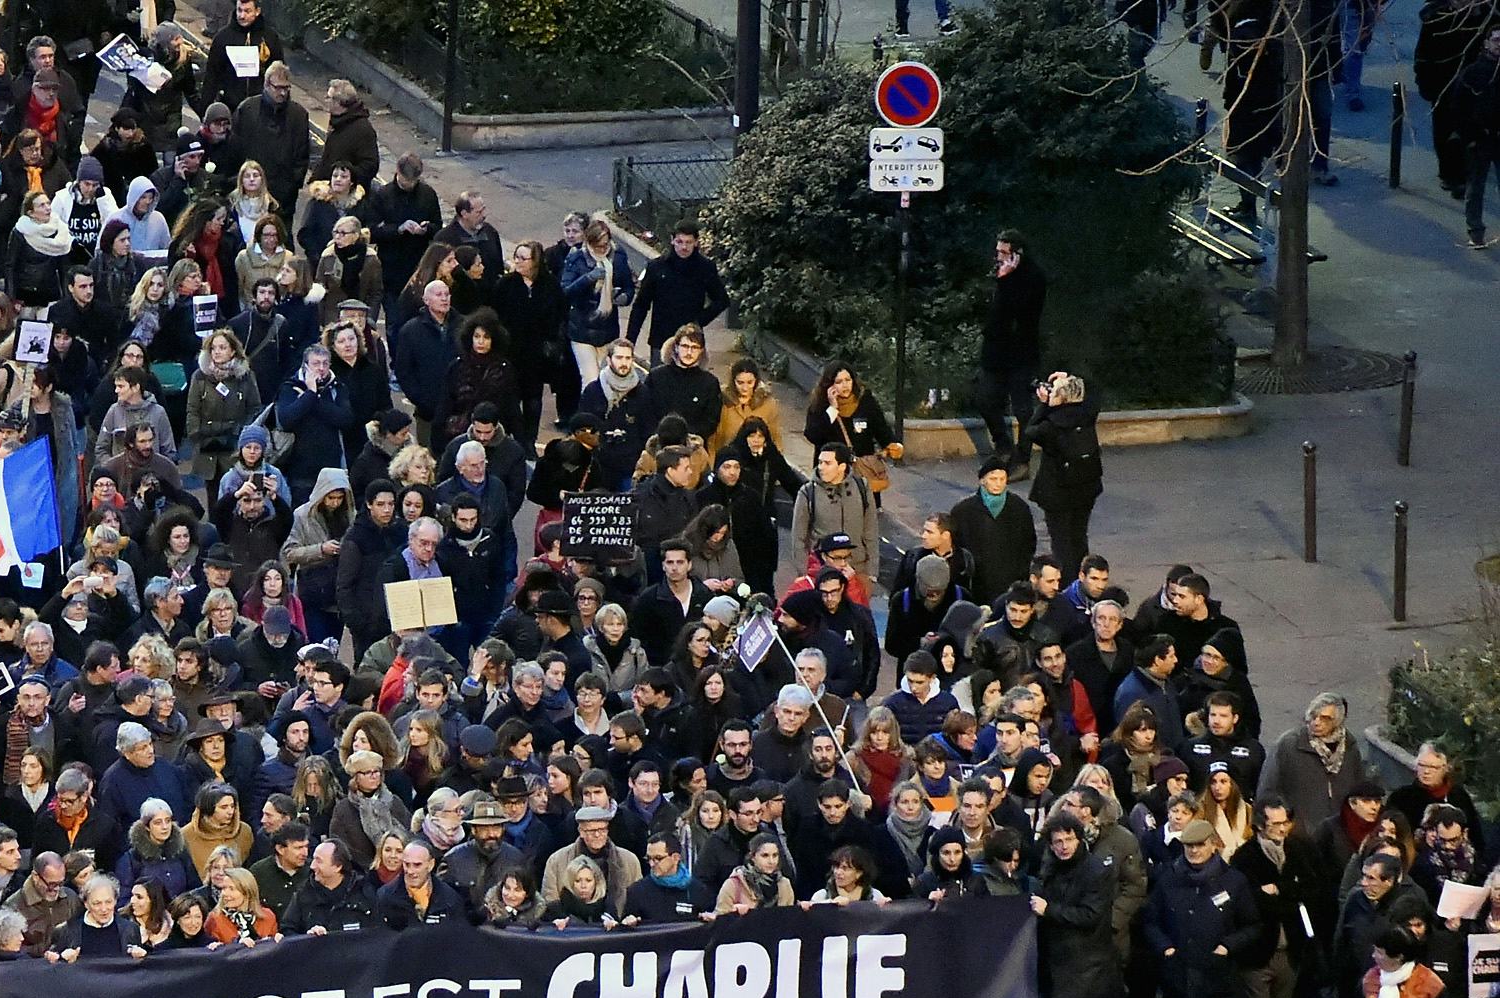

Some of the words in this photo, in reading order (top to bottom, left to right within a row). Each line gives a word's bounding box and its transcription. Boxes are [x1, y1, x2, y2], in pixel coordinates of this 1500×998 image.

[69, 218, 80, 230] JE
[82, 218, 99, 230] SUI
[568, 496, 592, 505] NOUS
[594, 495, 632, 505] SOMMES
[580, 506, 621, 514] ENCORE
[571, 515, 584, 526] 64
[568, 526, 582, 535] DE
[569, 536, 584, 544] EN
[590, 536, 633, 547] FRANCE!
